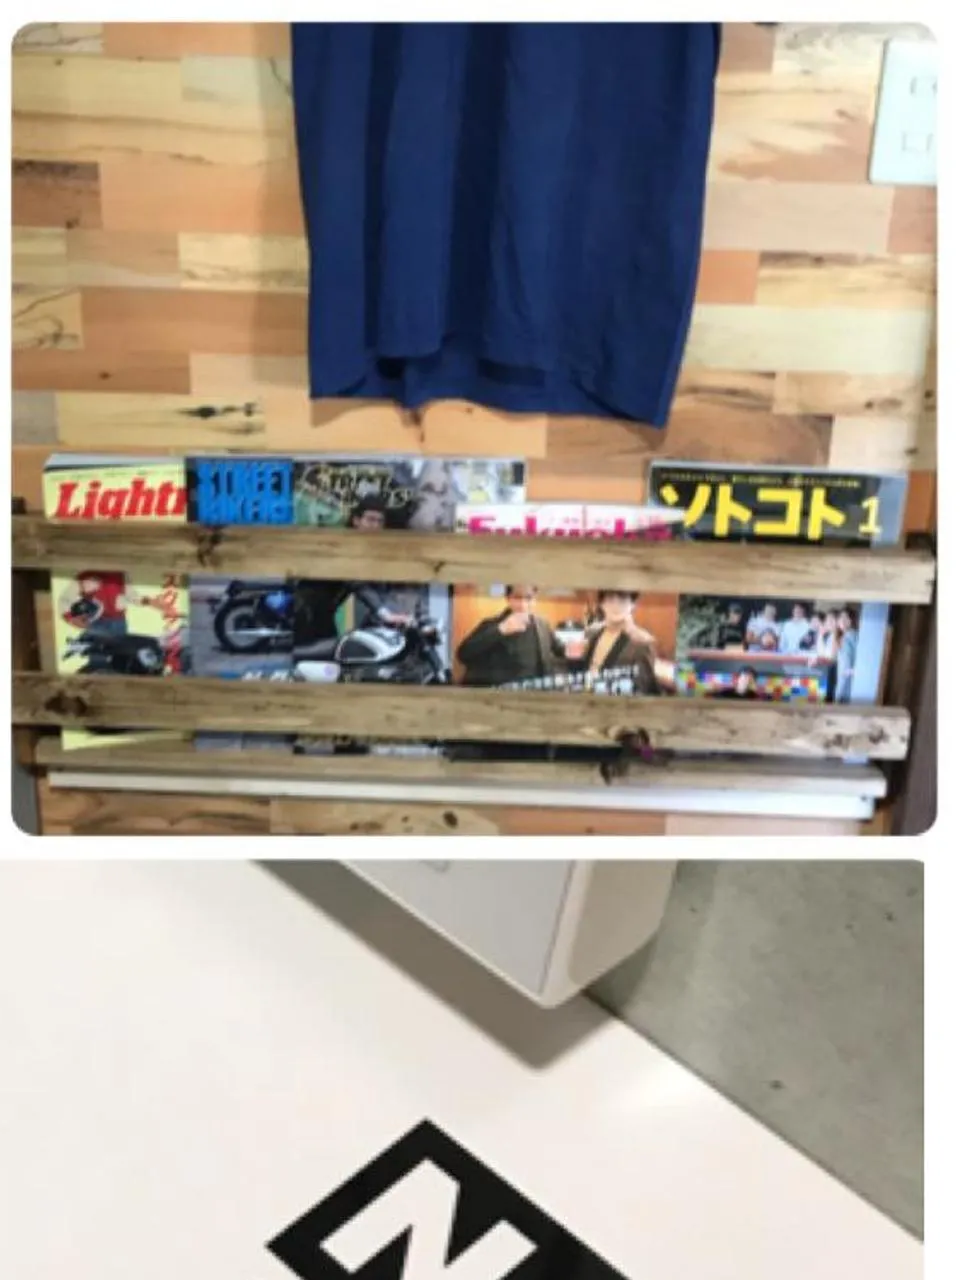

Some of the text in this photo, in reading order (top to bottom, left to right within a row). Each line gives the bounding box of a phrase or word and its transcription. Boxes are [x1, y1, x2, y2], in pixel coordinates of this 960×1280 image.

[660, 483, 846, 540] ソトコト
[858, 496, 883, 533] 1
